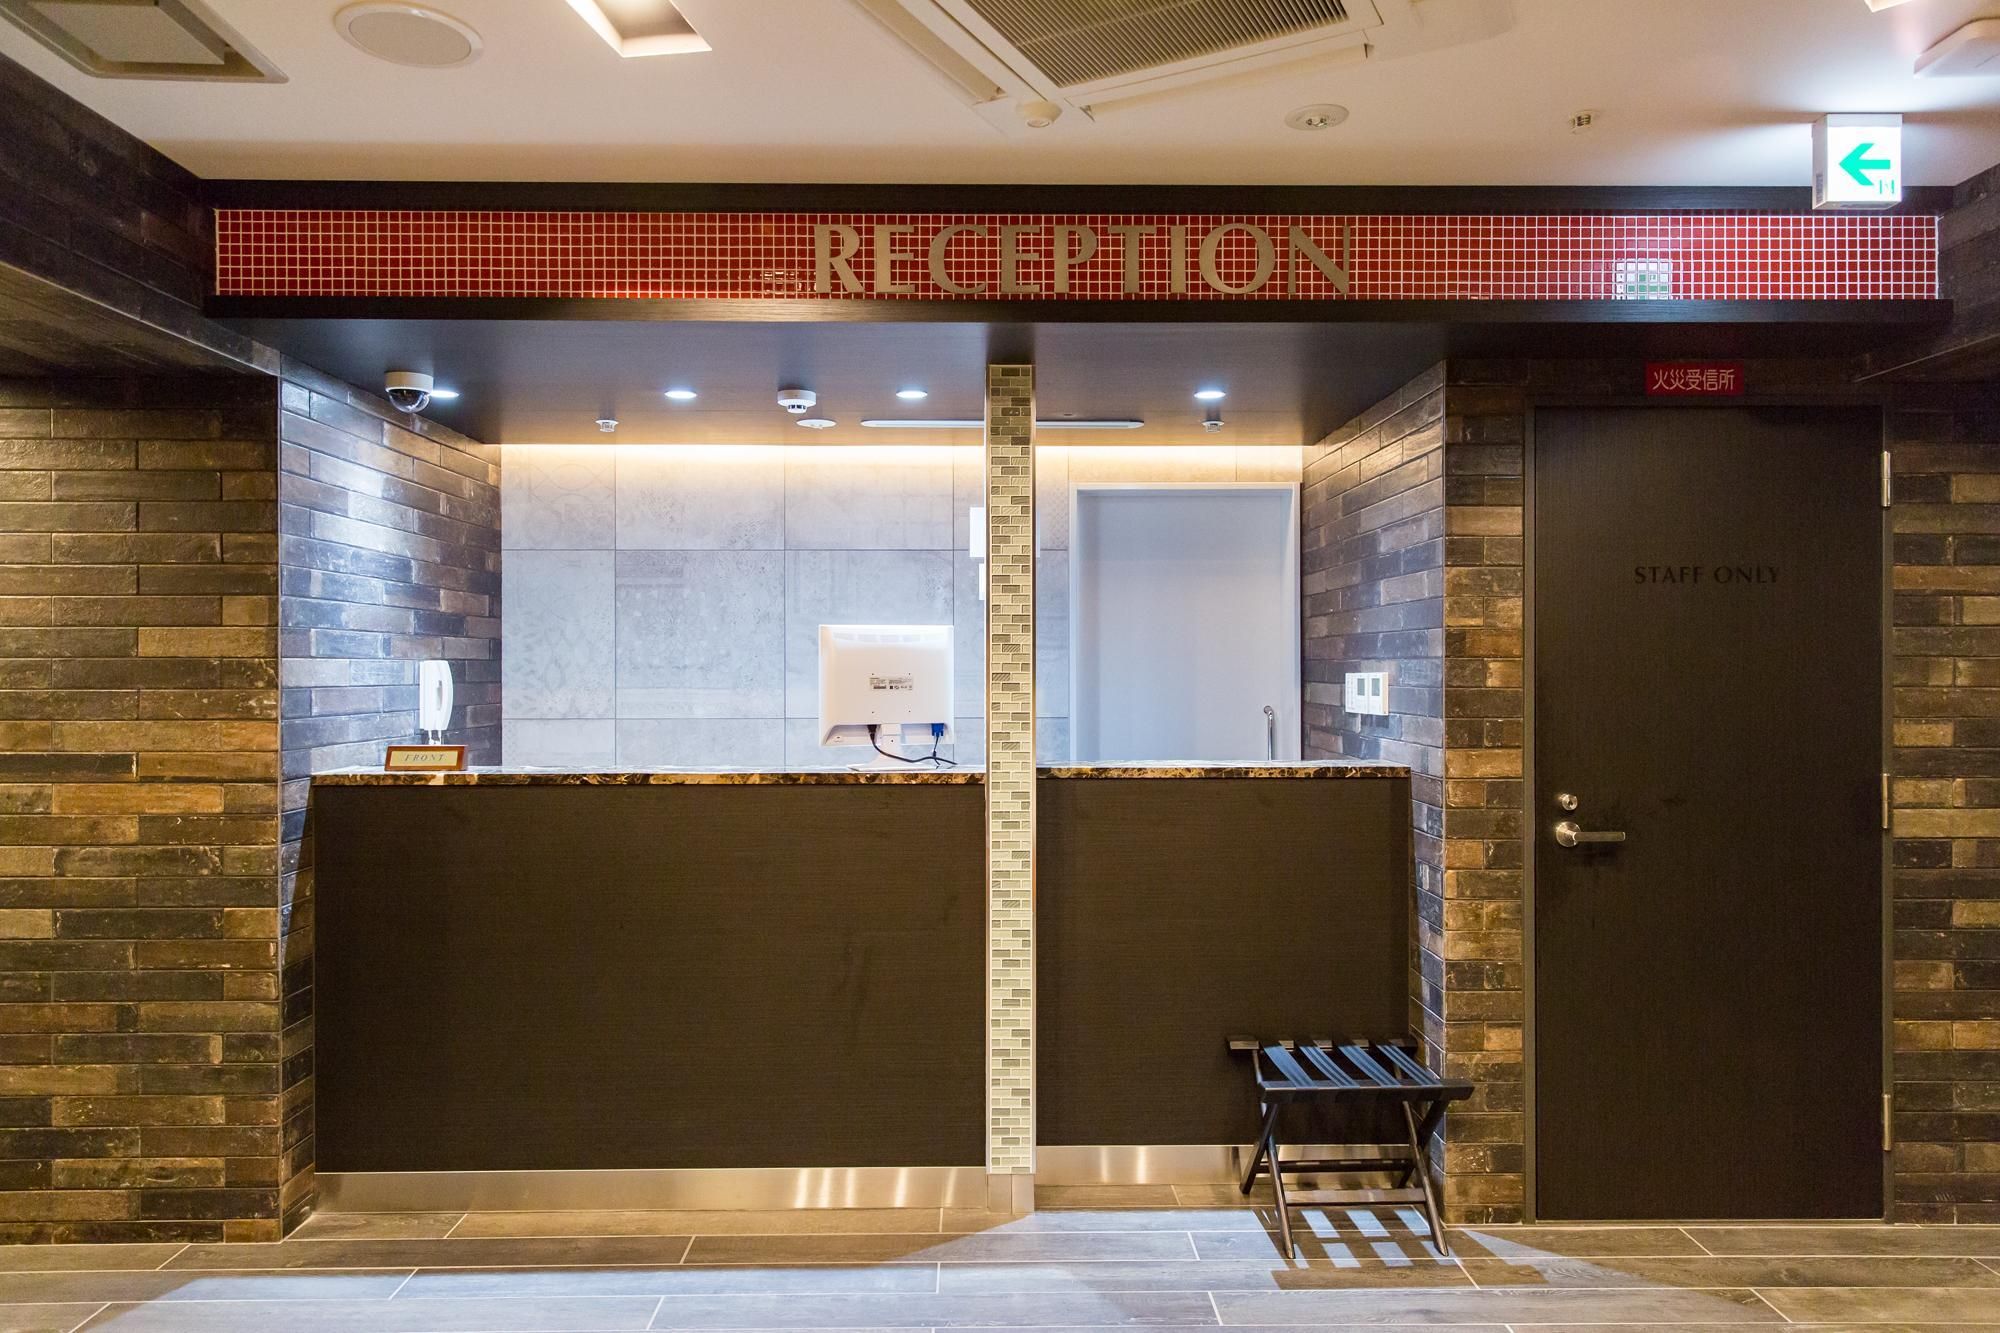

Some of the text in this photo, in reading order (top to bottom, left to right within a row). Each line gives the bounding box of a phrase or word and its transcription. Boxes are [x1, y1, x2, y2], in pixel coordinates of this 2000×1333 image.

[813, 222, 1351, 295] RECEPTION
[1652, 369, 1735, 391] 火災受信所
[1634, 565, 1779, 584] STAFF ONLY
